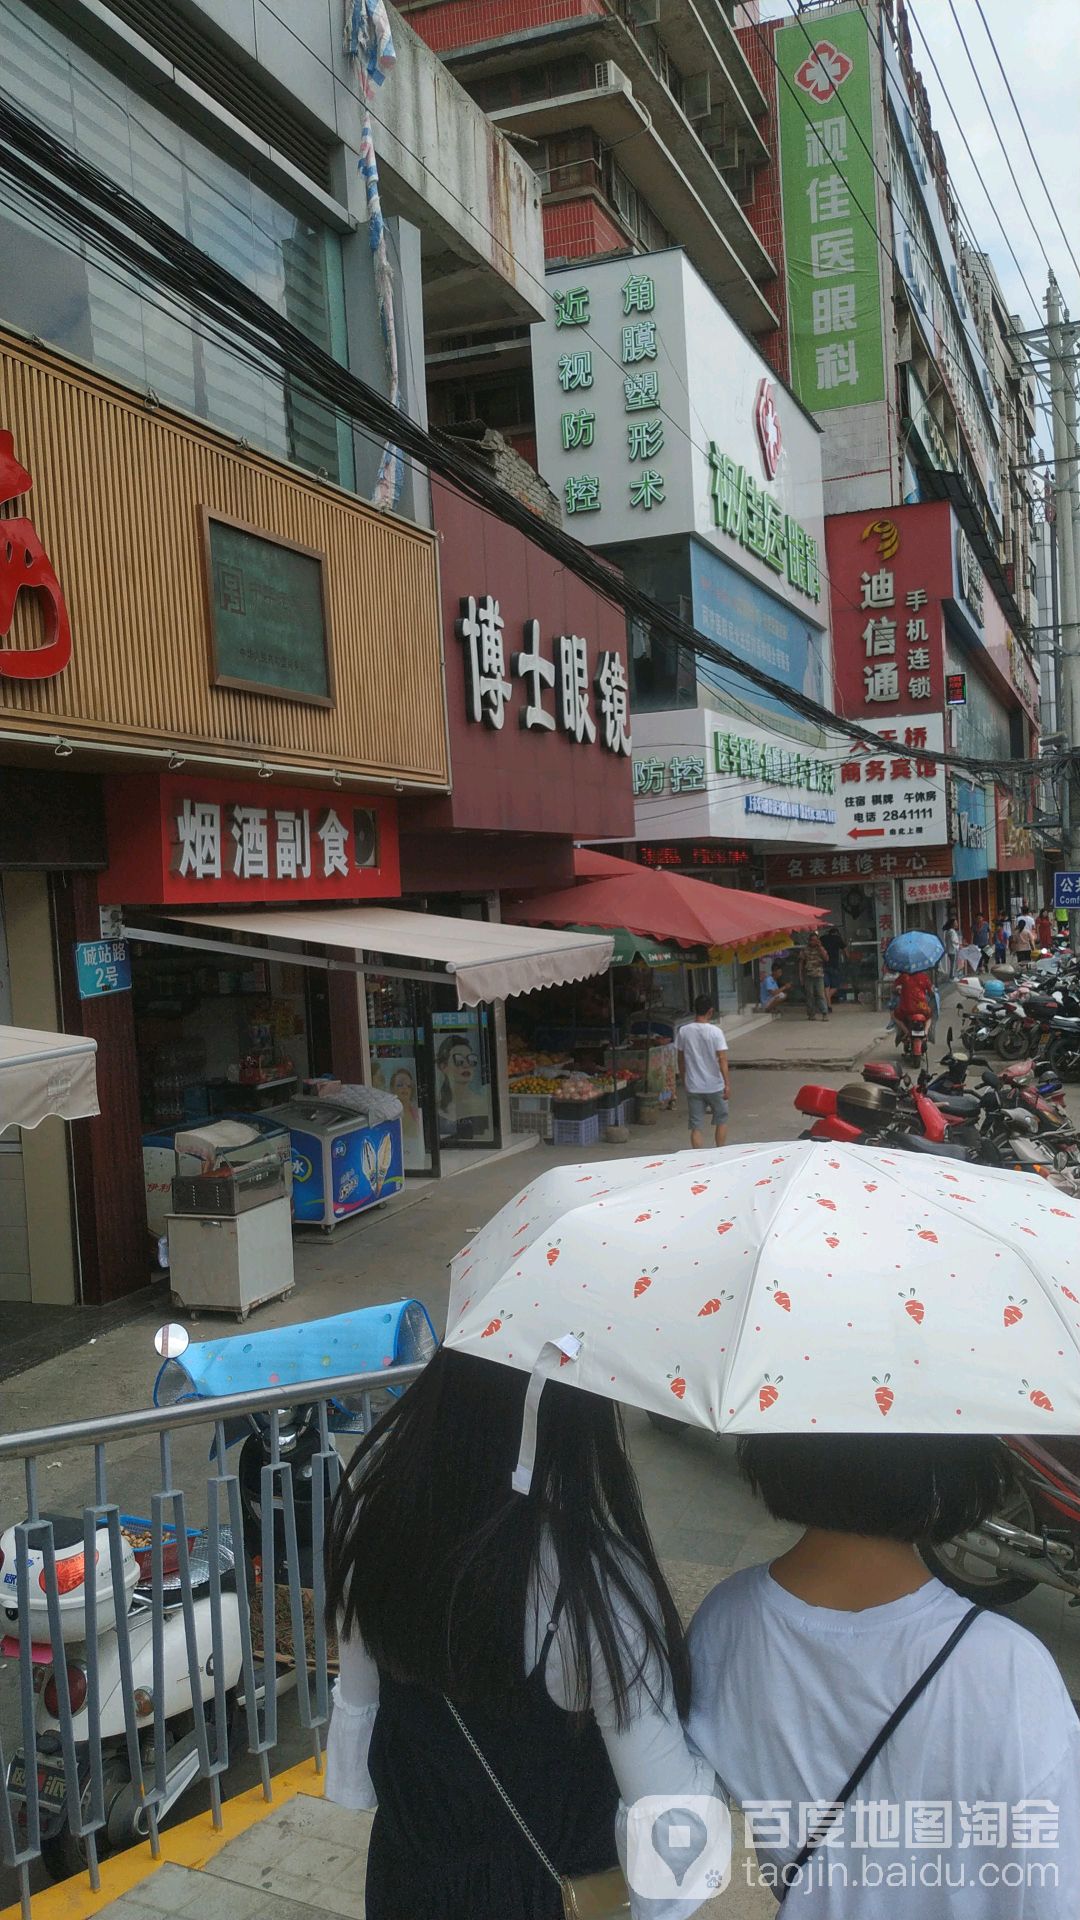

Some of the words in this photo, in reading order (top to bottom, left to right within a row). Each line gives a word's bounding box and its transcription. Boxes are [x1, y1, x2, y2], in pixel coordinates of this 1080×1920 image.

[805, 115, 859, 390] 视佳医眼科
[554, 286, 601, 514] 近视防控
[621, 274, 666, 509] 角膜塑形术
[860, 568, 900, 703] 迪信通
[905, 588, 931, 699] 手机连锁
[455, 595, 633, 757] 博士眼镜
[632, 754, 706, 795] 防控
[840, 757, 937, 784] 商务宾馆
[844, 795, 866, 808] 住宿
[853, 811, 876, 823] 电话
[883, 808, 933, 821] 2841111
[176, 798, 350, 880] 烟酒副食
[787, 852, 928, 878] 名表维修中心
[907, 881, 949, 898] 名表维修
[83, 942, 126, 966] 城站路
[95, 966, 119, 988] 2号
